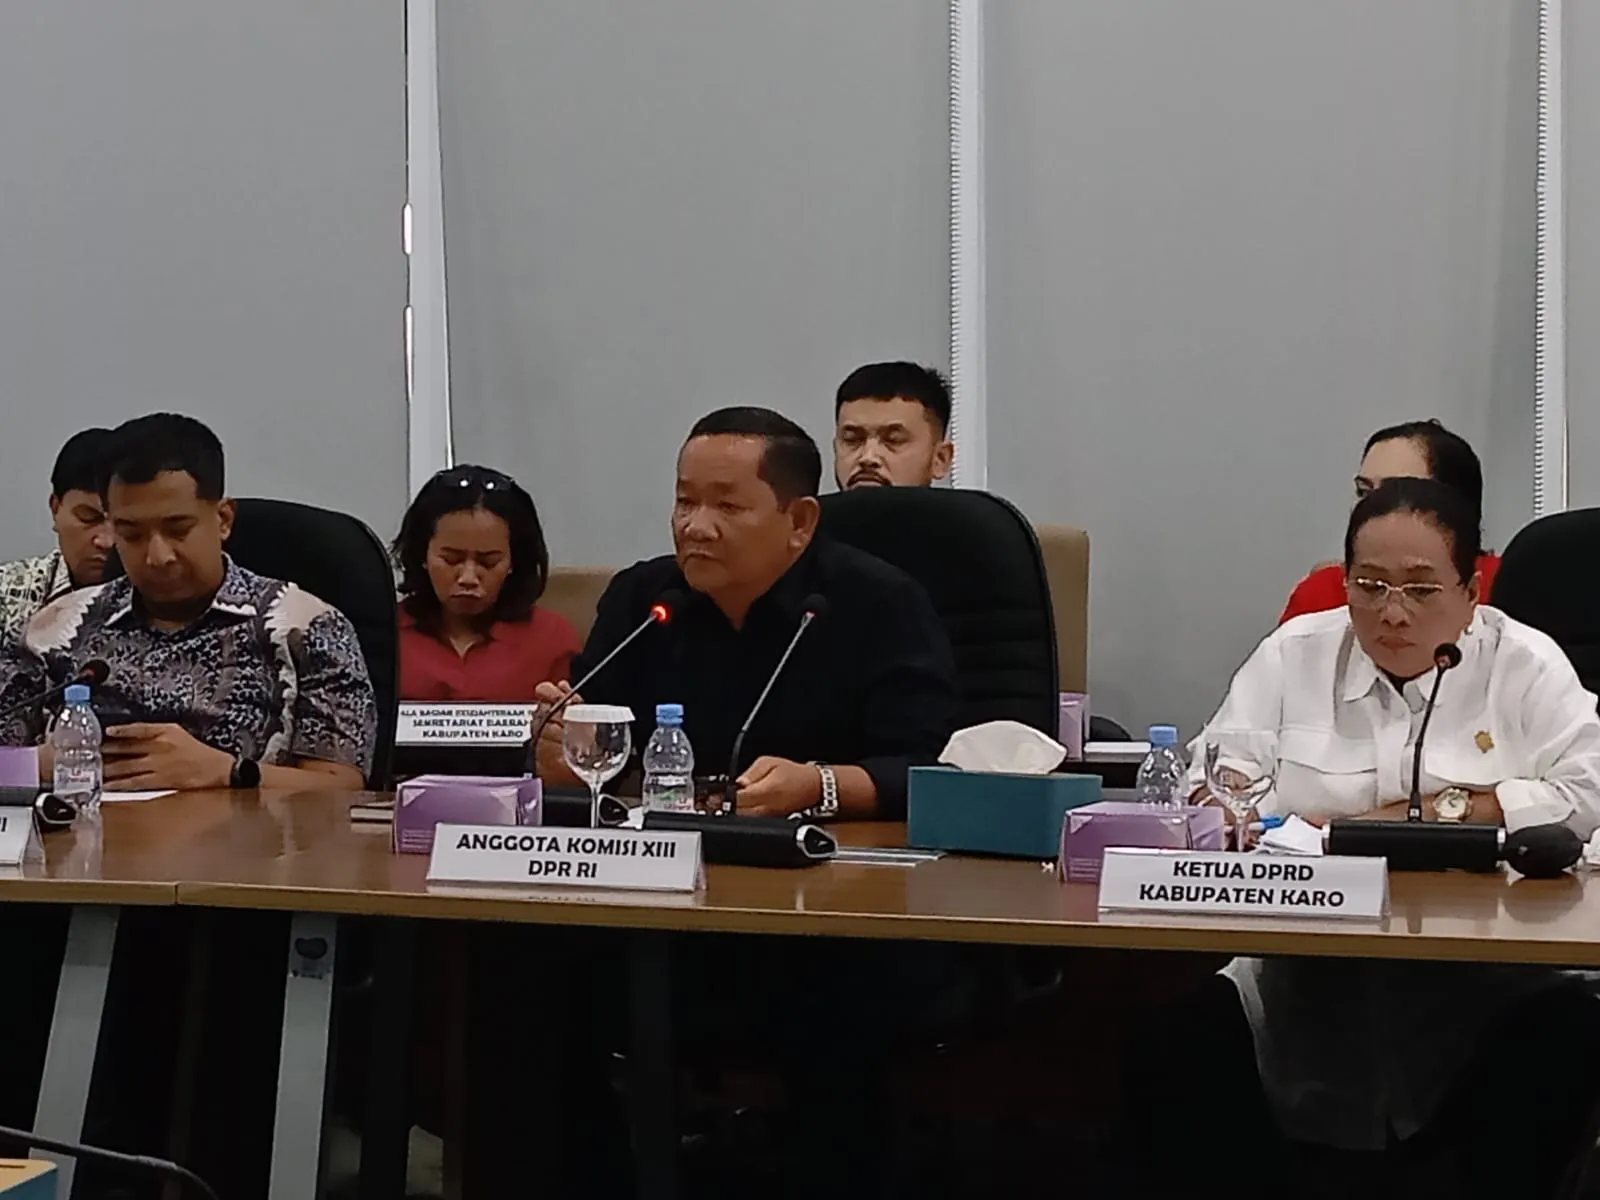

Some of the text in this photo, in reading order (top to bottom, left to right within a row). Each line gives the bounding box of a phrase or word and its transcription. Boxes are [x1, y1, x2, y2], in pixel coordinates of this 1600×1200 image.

[422, 729, 524, 739] KABUPATEN KARO
[456, 833, 561, 853] ANGGOTA
[566, 837, 637, 857] KOMISI
[641, 840, 676, 858] XIII
[528, 859, 597, 879] DPR RI
[1173, 860, 1314, 881] KETUA DPRD
[1139, 883, 1345, 907] KABUPATEN KARO
